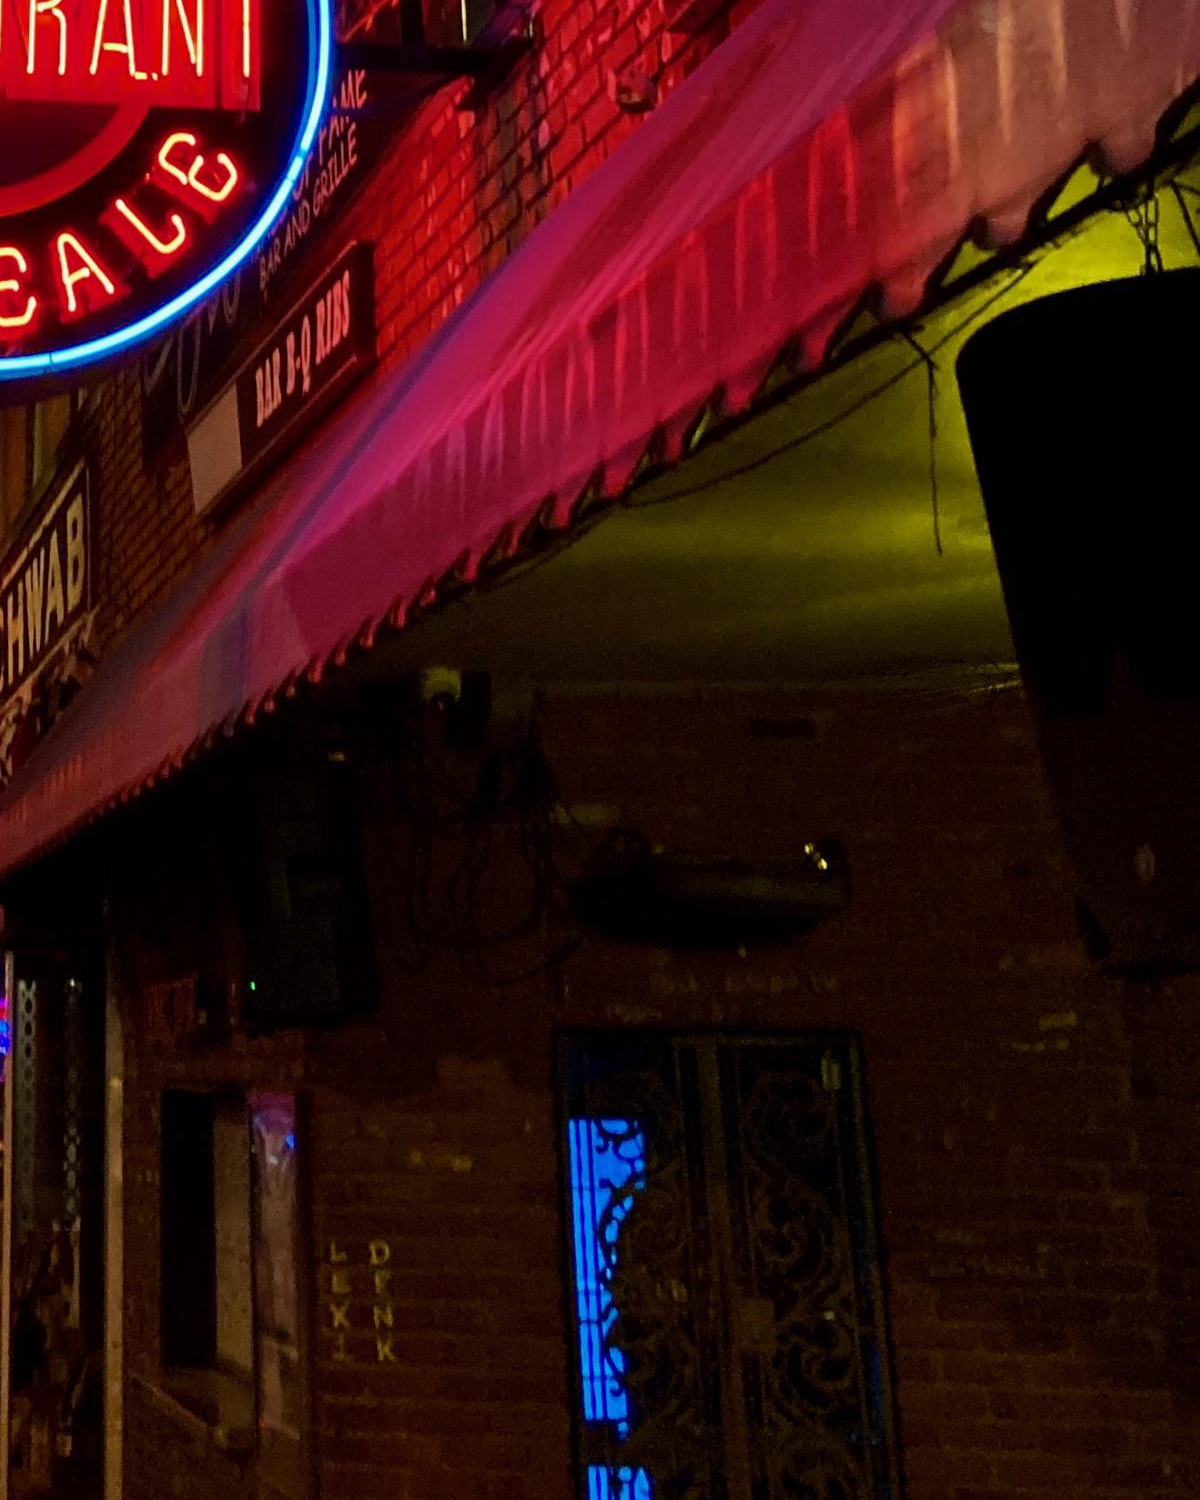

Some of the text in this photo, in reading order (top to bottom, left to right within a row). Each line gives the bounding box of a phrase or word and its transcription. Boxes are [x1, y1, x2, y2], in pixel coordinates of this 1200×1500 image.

[283, 198, 311, 259] AND
[312, 120, 359, 218] GRILLE
[255, 347, 282, 429] BAR
[315, 268, 351, 366] RIBS
